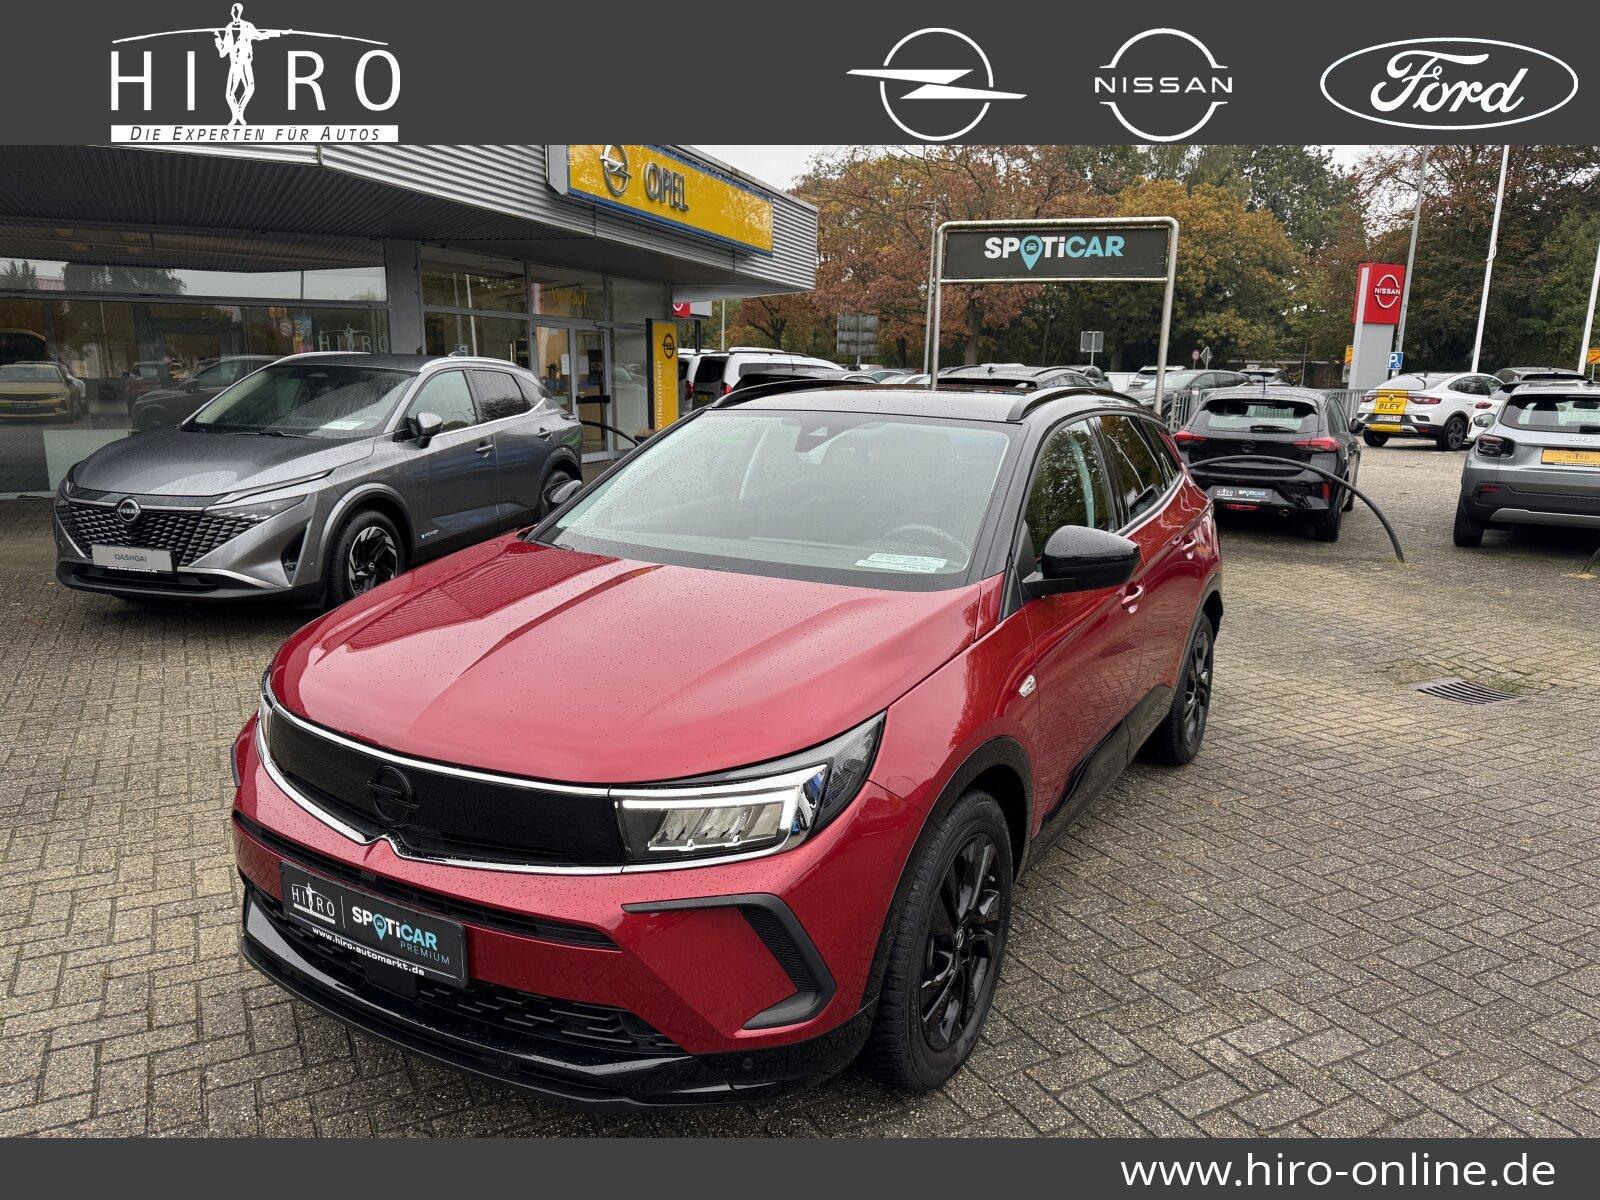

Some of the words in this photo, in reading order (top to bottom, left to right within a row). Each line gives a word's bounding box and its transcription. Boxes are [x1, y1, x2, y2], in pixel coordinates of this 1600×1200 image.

[643, 161, 690, 213] OPEL
[1374, 287, 1401, 295] NISSAN
[1388, 353, 1398, 368] P
[1569, 434, 1594, 444] Jeep
[114, 553, 148, 563] QASHQAI
[291, 884, 336, 918] HIRO
[311, 925, 425, 977] www.hiro-automarkt.de
[400, 941, 450, 966] PREMIUM
